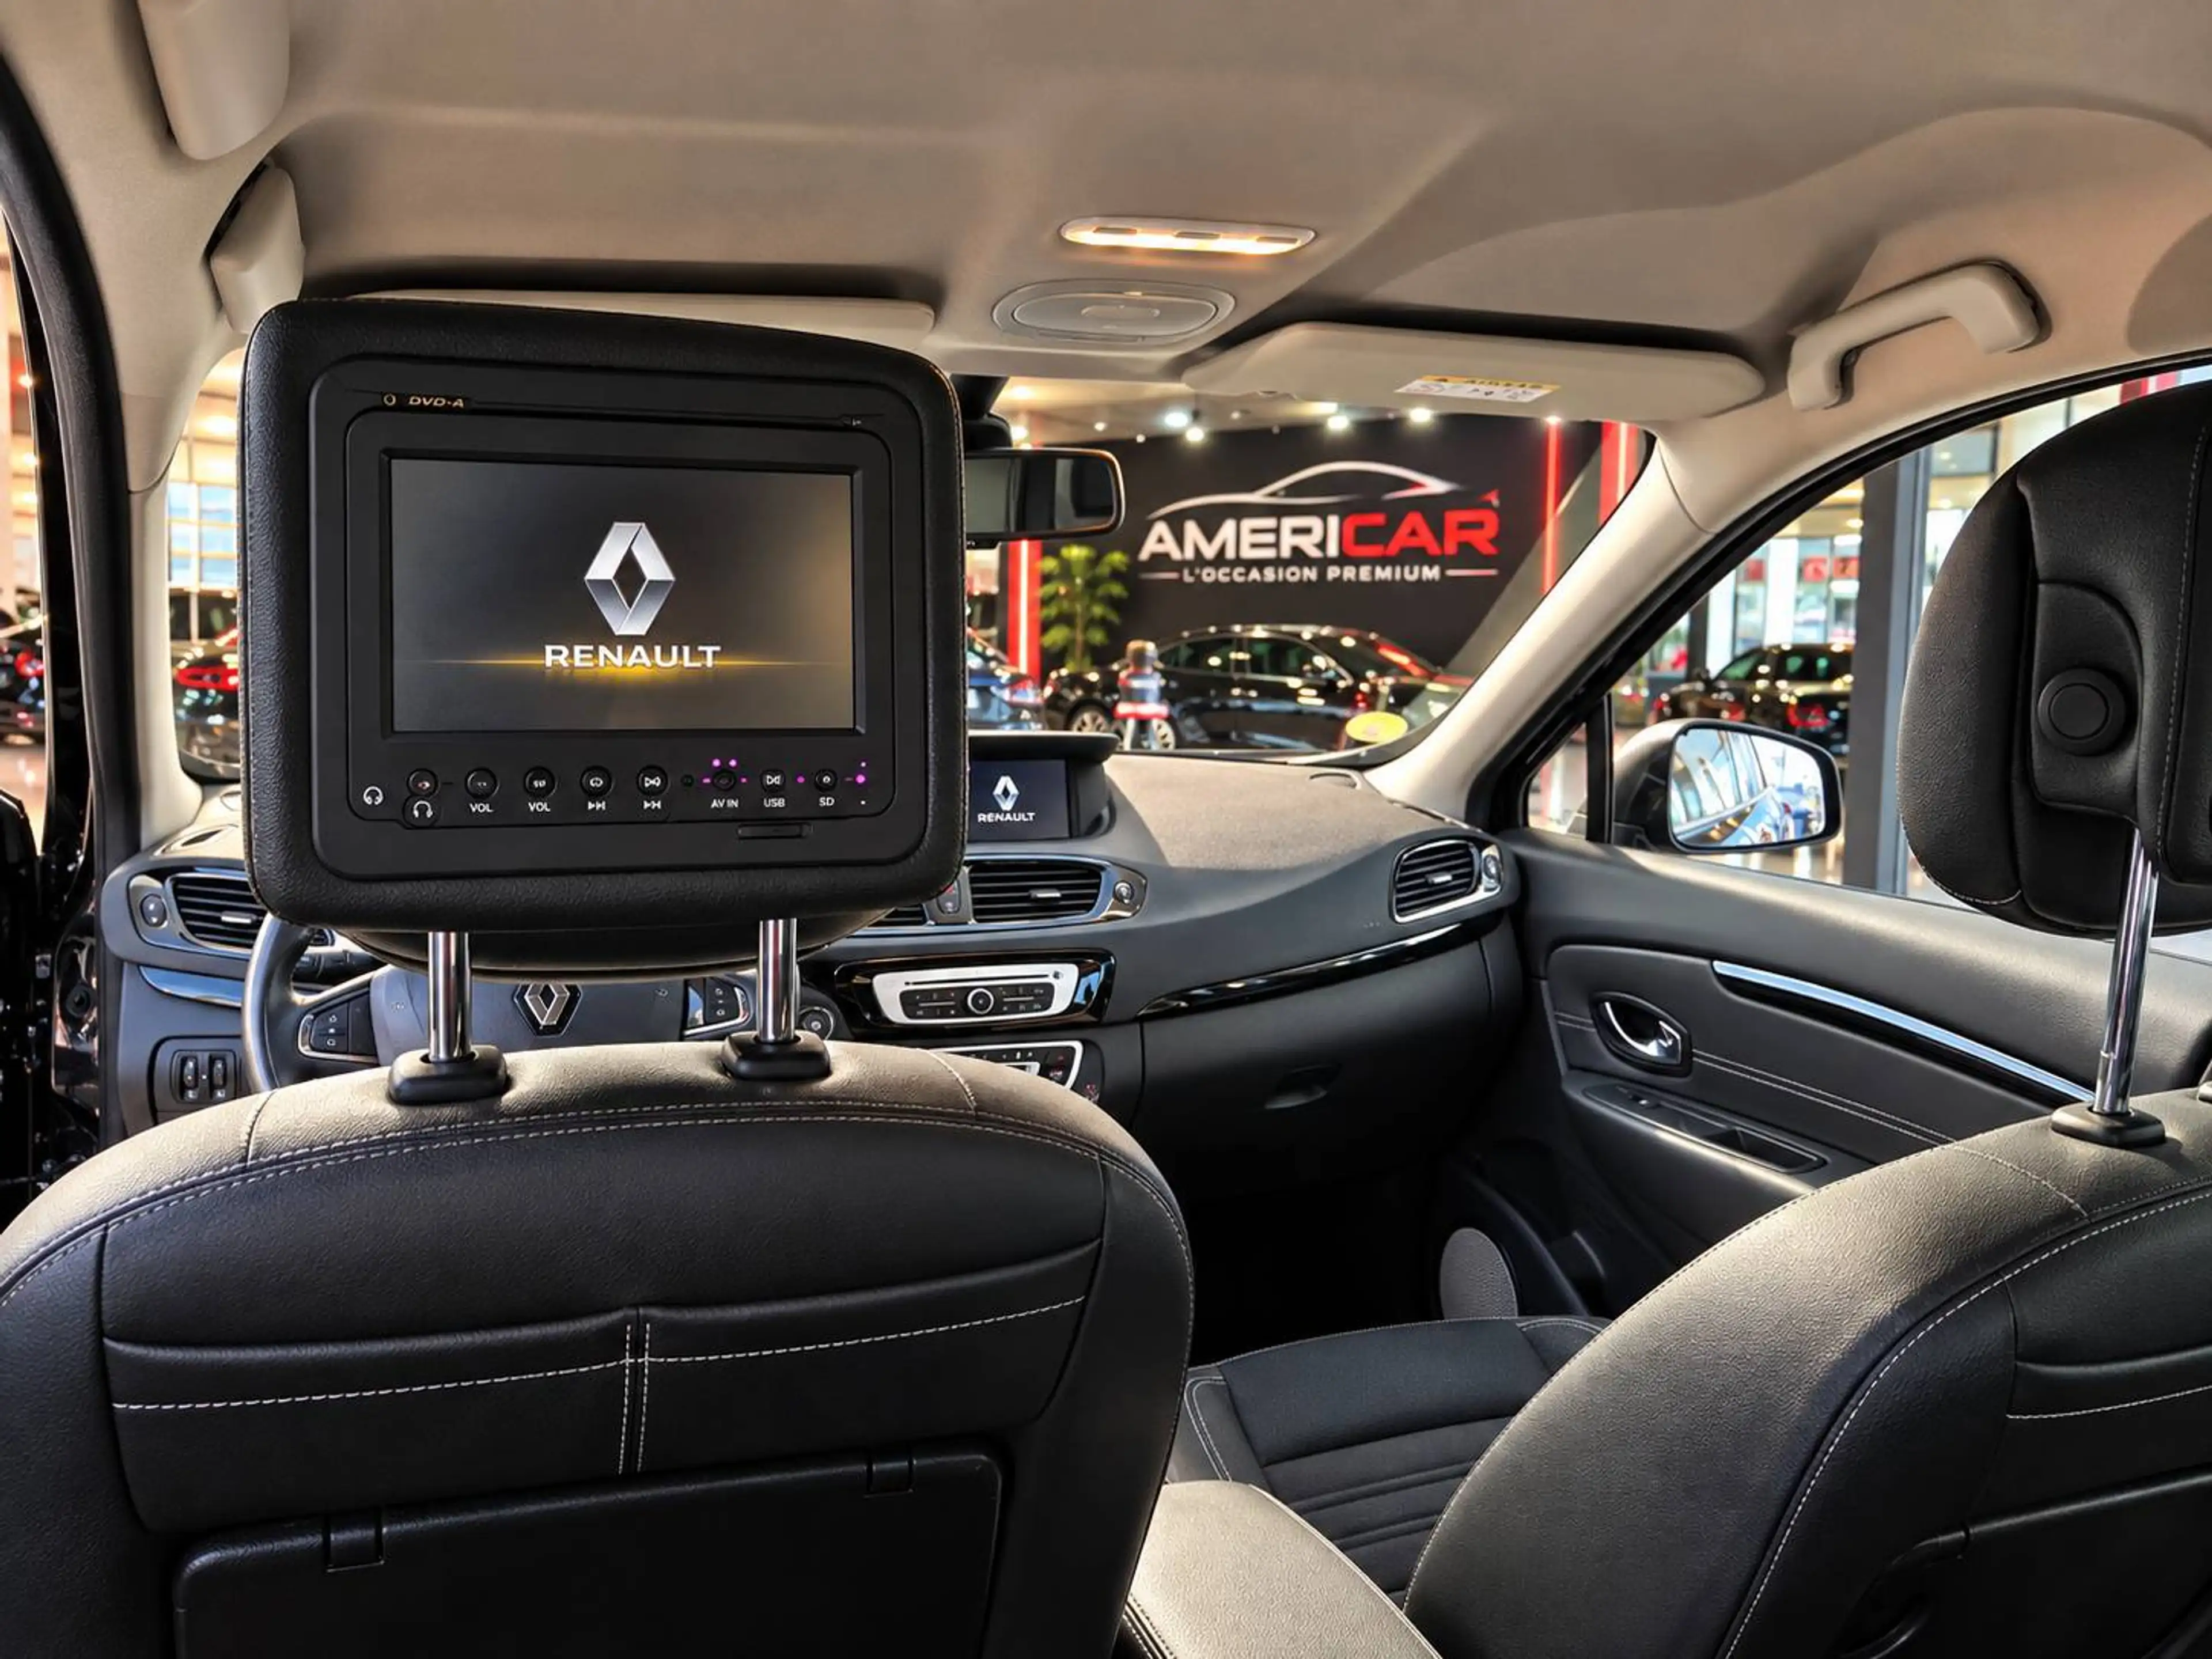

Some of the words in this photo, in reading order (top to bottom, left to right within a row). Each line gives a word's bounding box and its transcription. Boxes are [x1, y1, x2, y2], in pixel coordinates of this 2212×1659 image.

[1138, 509, 1500, 561] AMERICAR
[1183, 566, 1317, 583] L'OCCASION
[1327, 565, 1441, 581] PREMIUM
[544, 645, 721, 668] RENAULT
[470, 802, 494, 813] VOL
[528, 802, 551, 812] VOL
[711, 799, 725, 809] AV
[726, 798, 739, 809] IN
[764, 798, 786, 808] USB
[819, 797, 835, 807] SD
[978, 812, 1035, 823] RENAULT
